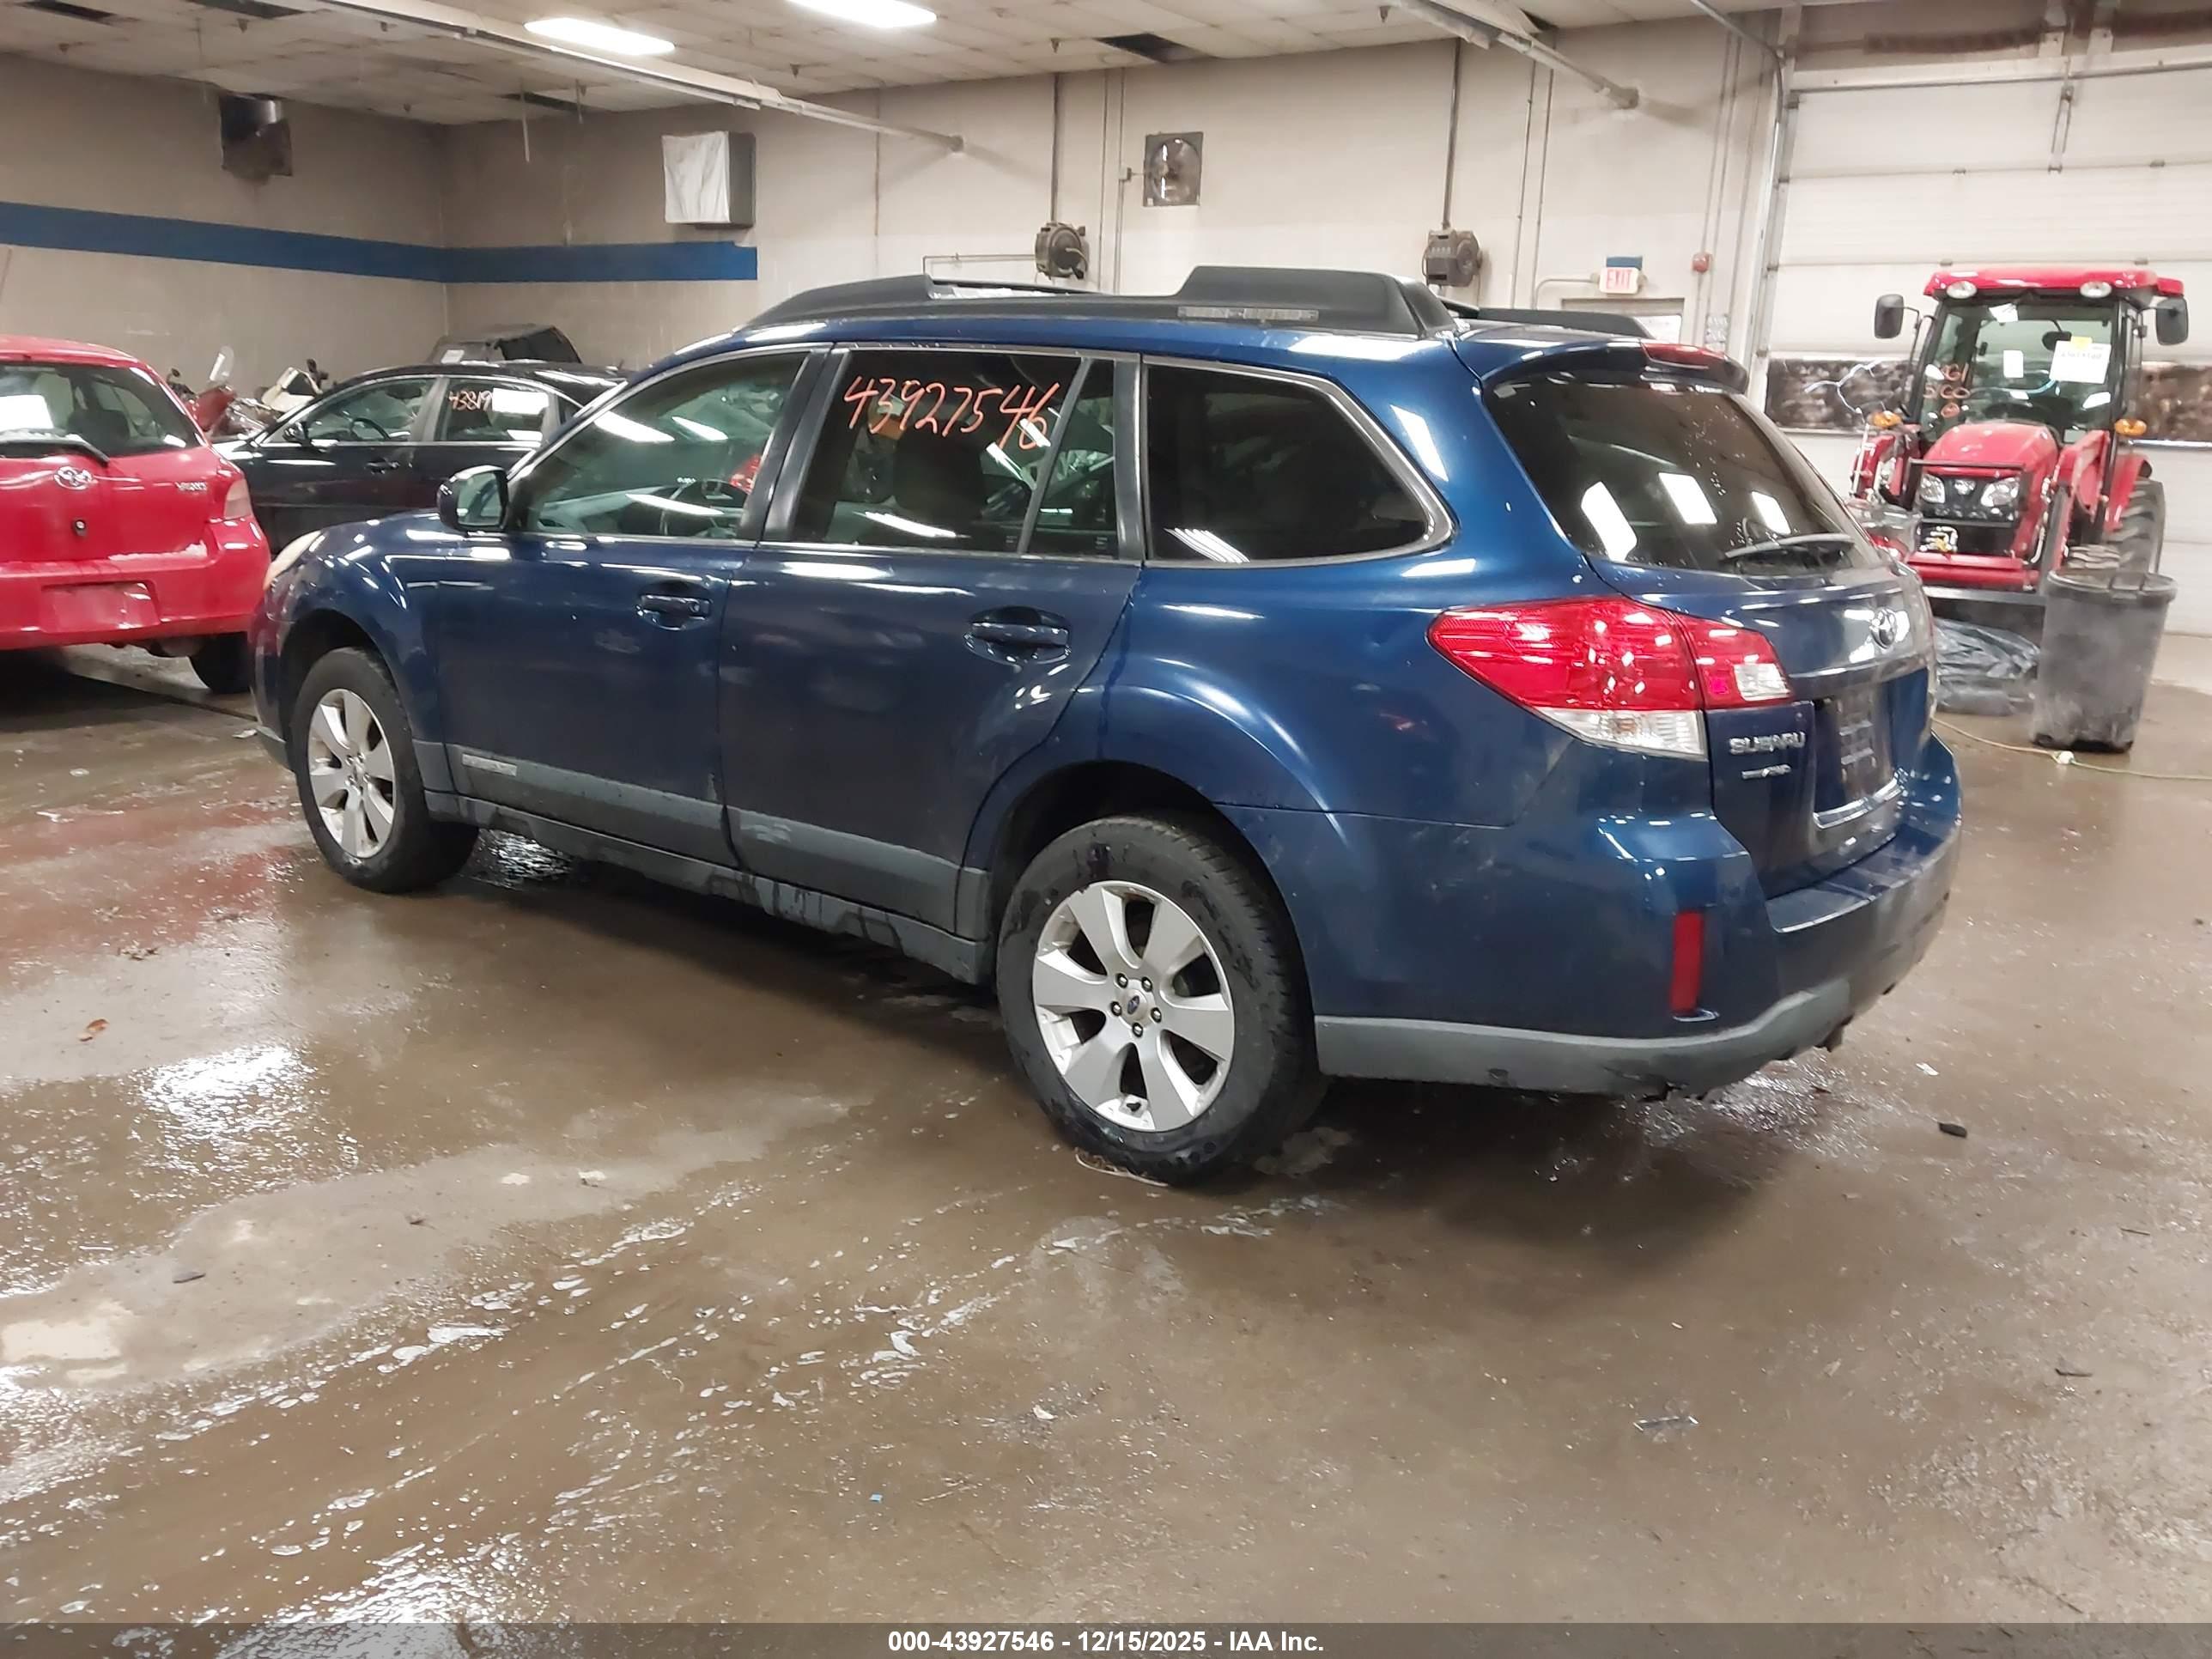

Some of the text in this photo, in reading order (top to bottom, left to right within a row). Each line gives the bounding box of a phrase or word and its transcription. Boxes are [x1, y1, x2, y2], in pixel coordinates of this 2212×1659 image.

[1606, 268, 1632, 289] EXIT
[843, 375, 1060, 450] 43927546
[1729, 731, 1806, 755] SUBARU
